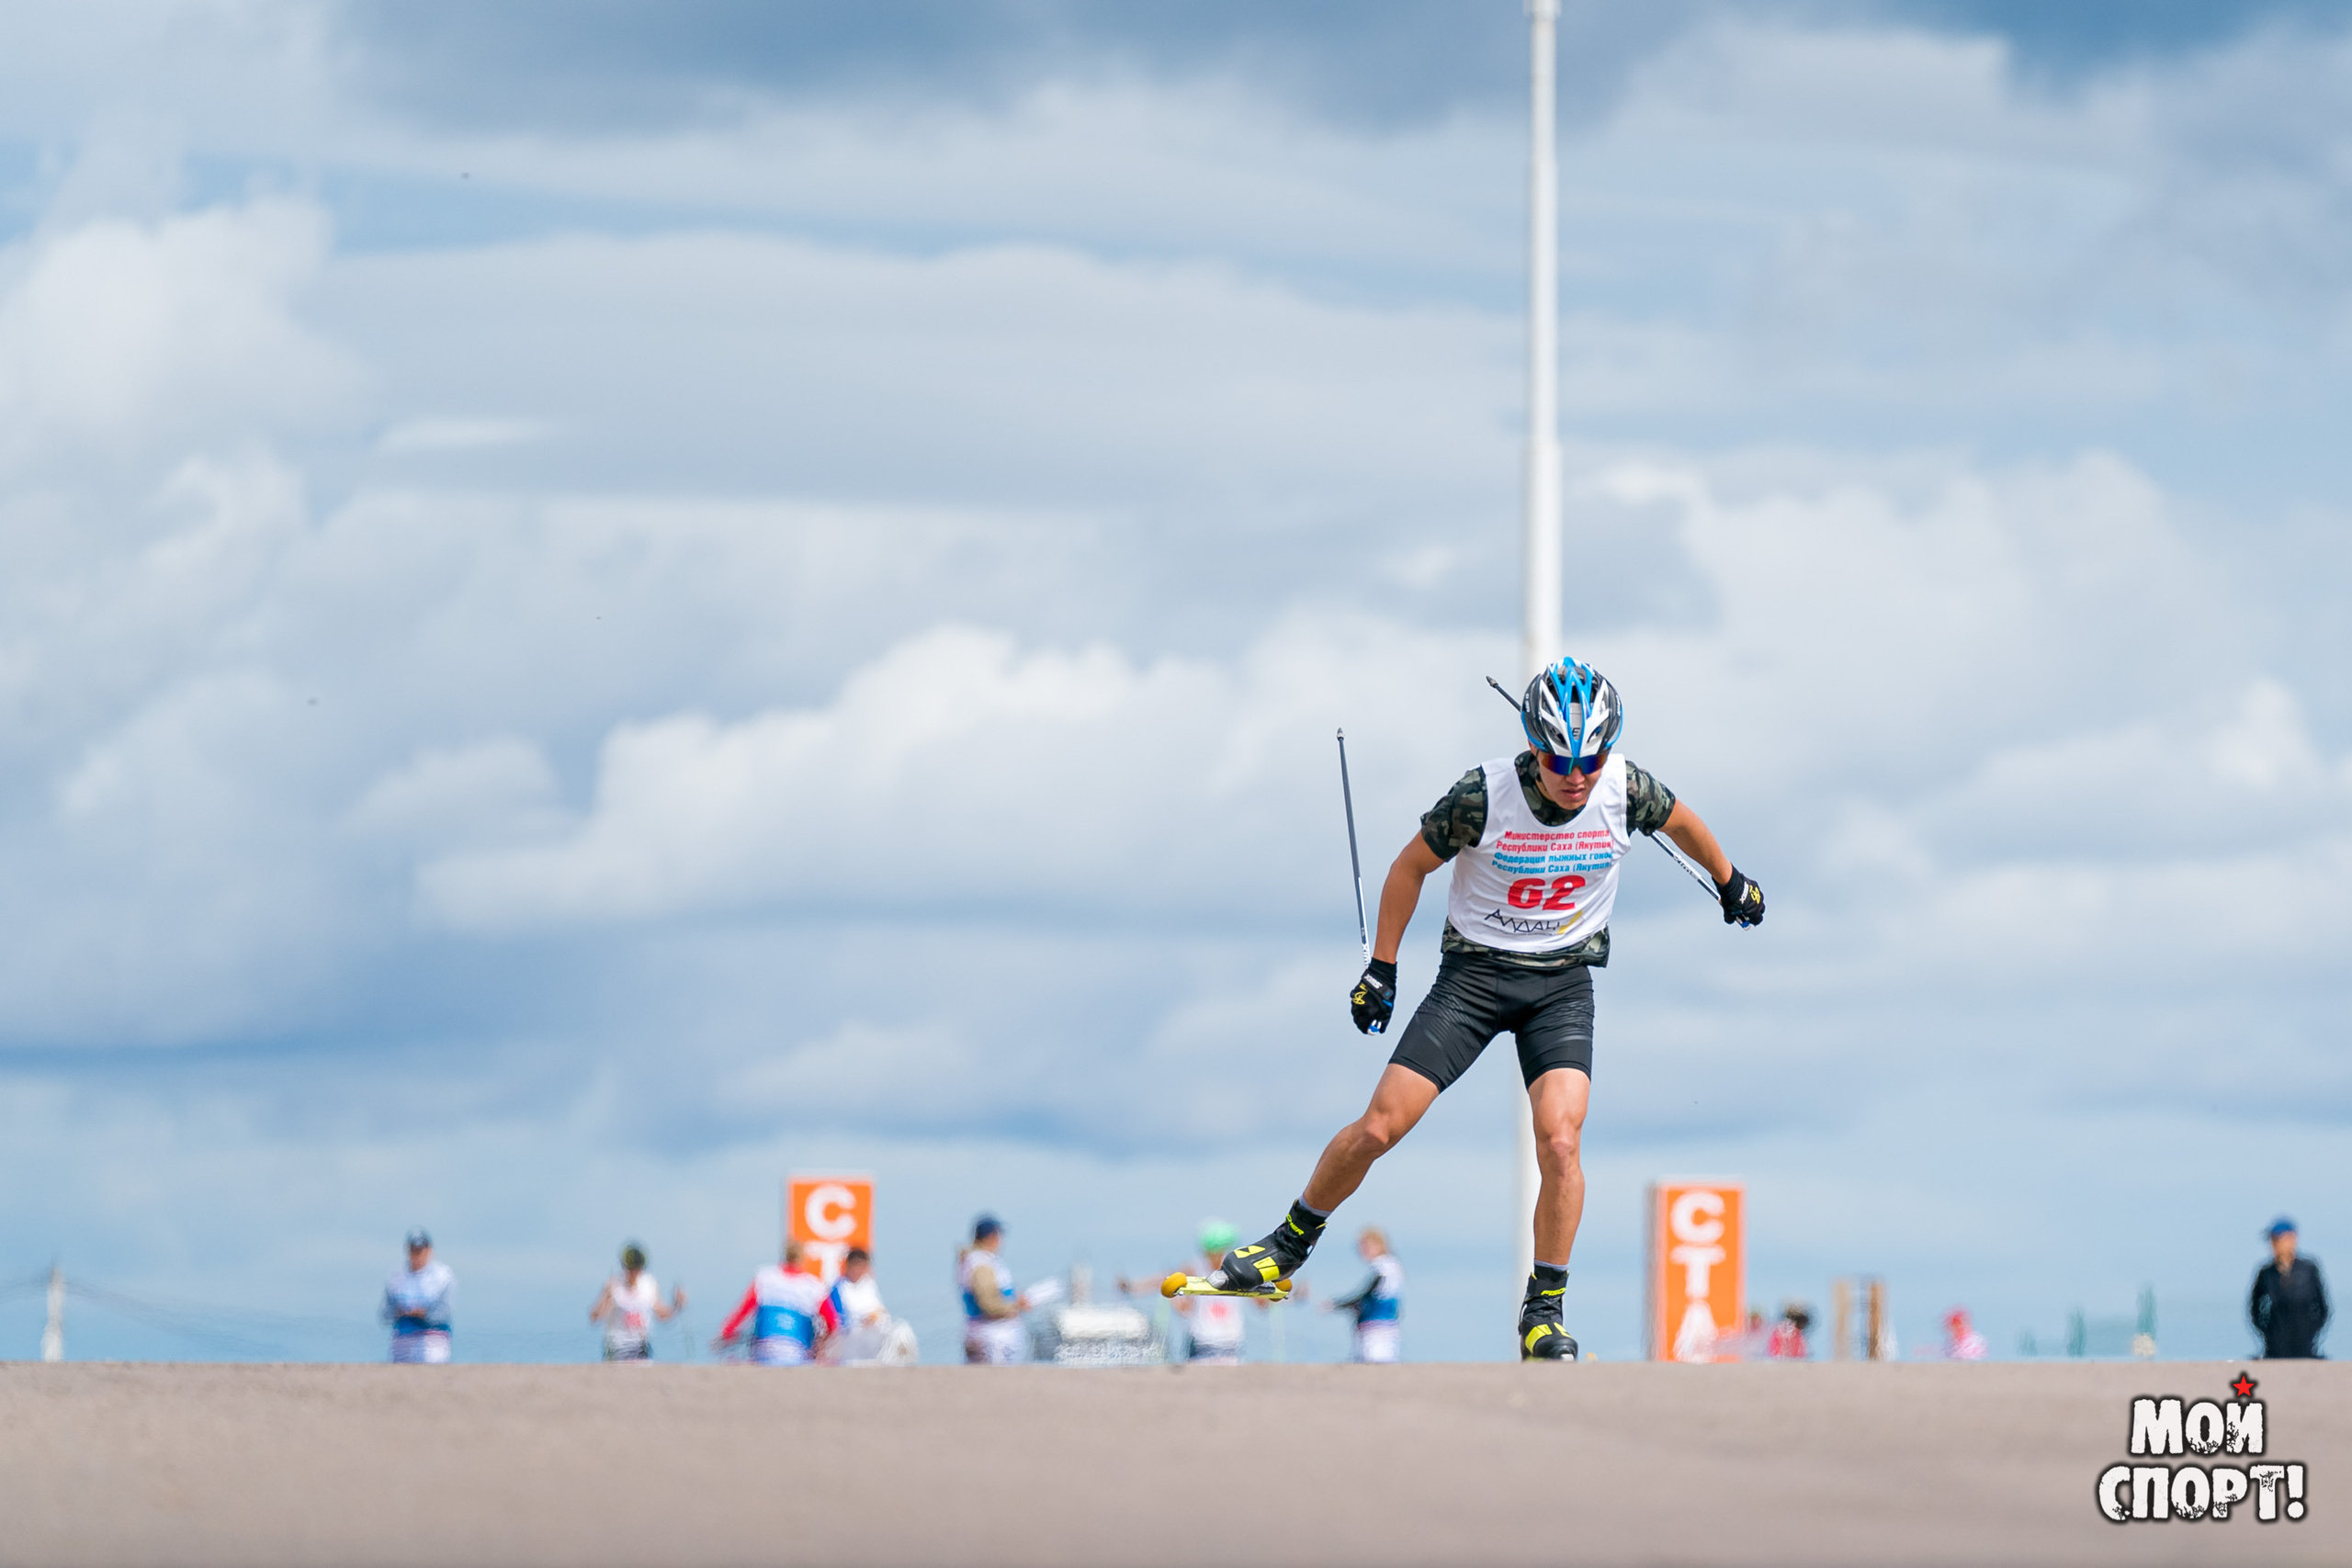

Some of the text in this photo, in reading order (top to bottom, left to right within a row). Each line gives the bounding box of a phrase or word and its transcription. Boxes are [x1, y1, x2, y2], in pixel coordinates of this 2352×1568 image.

[1504, 829, 1610, 842] Министерство спорта
[1496, 840, 1548, 853] Республики
[1550, 842, 1573, 851] Саха
[1494, 852, 1545, 864] Федерация
[1548, 853, 1587, 863] лыжных
[1492, 860, 1545, 874] Республики
[1548, 864, 1570, 873] Саха
[1508, 874, 1586, 910] 62
